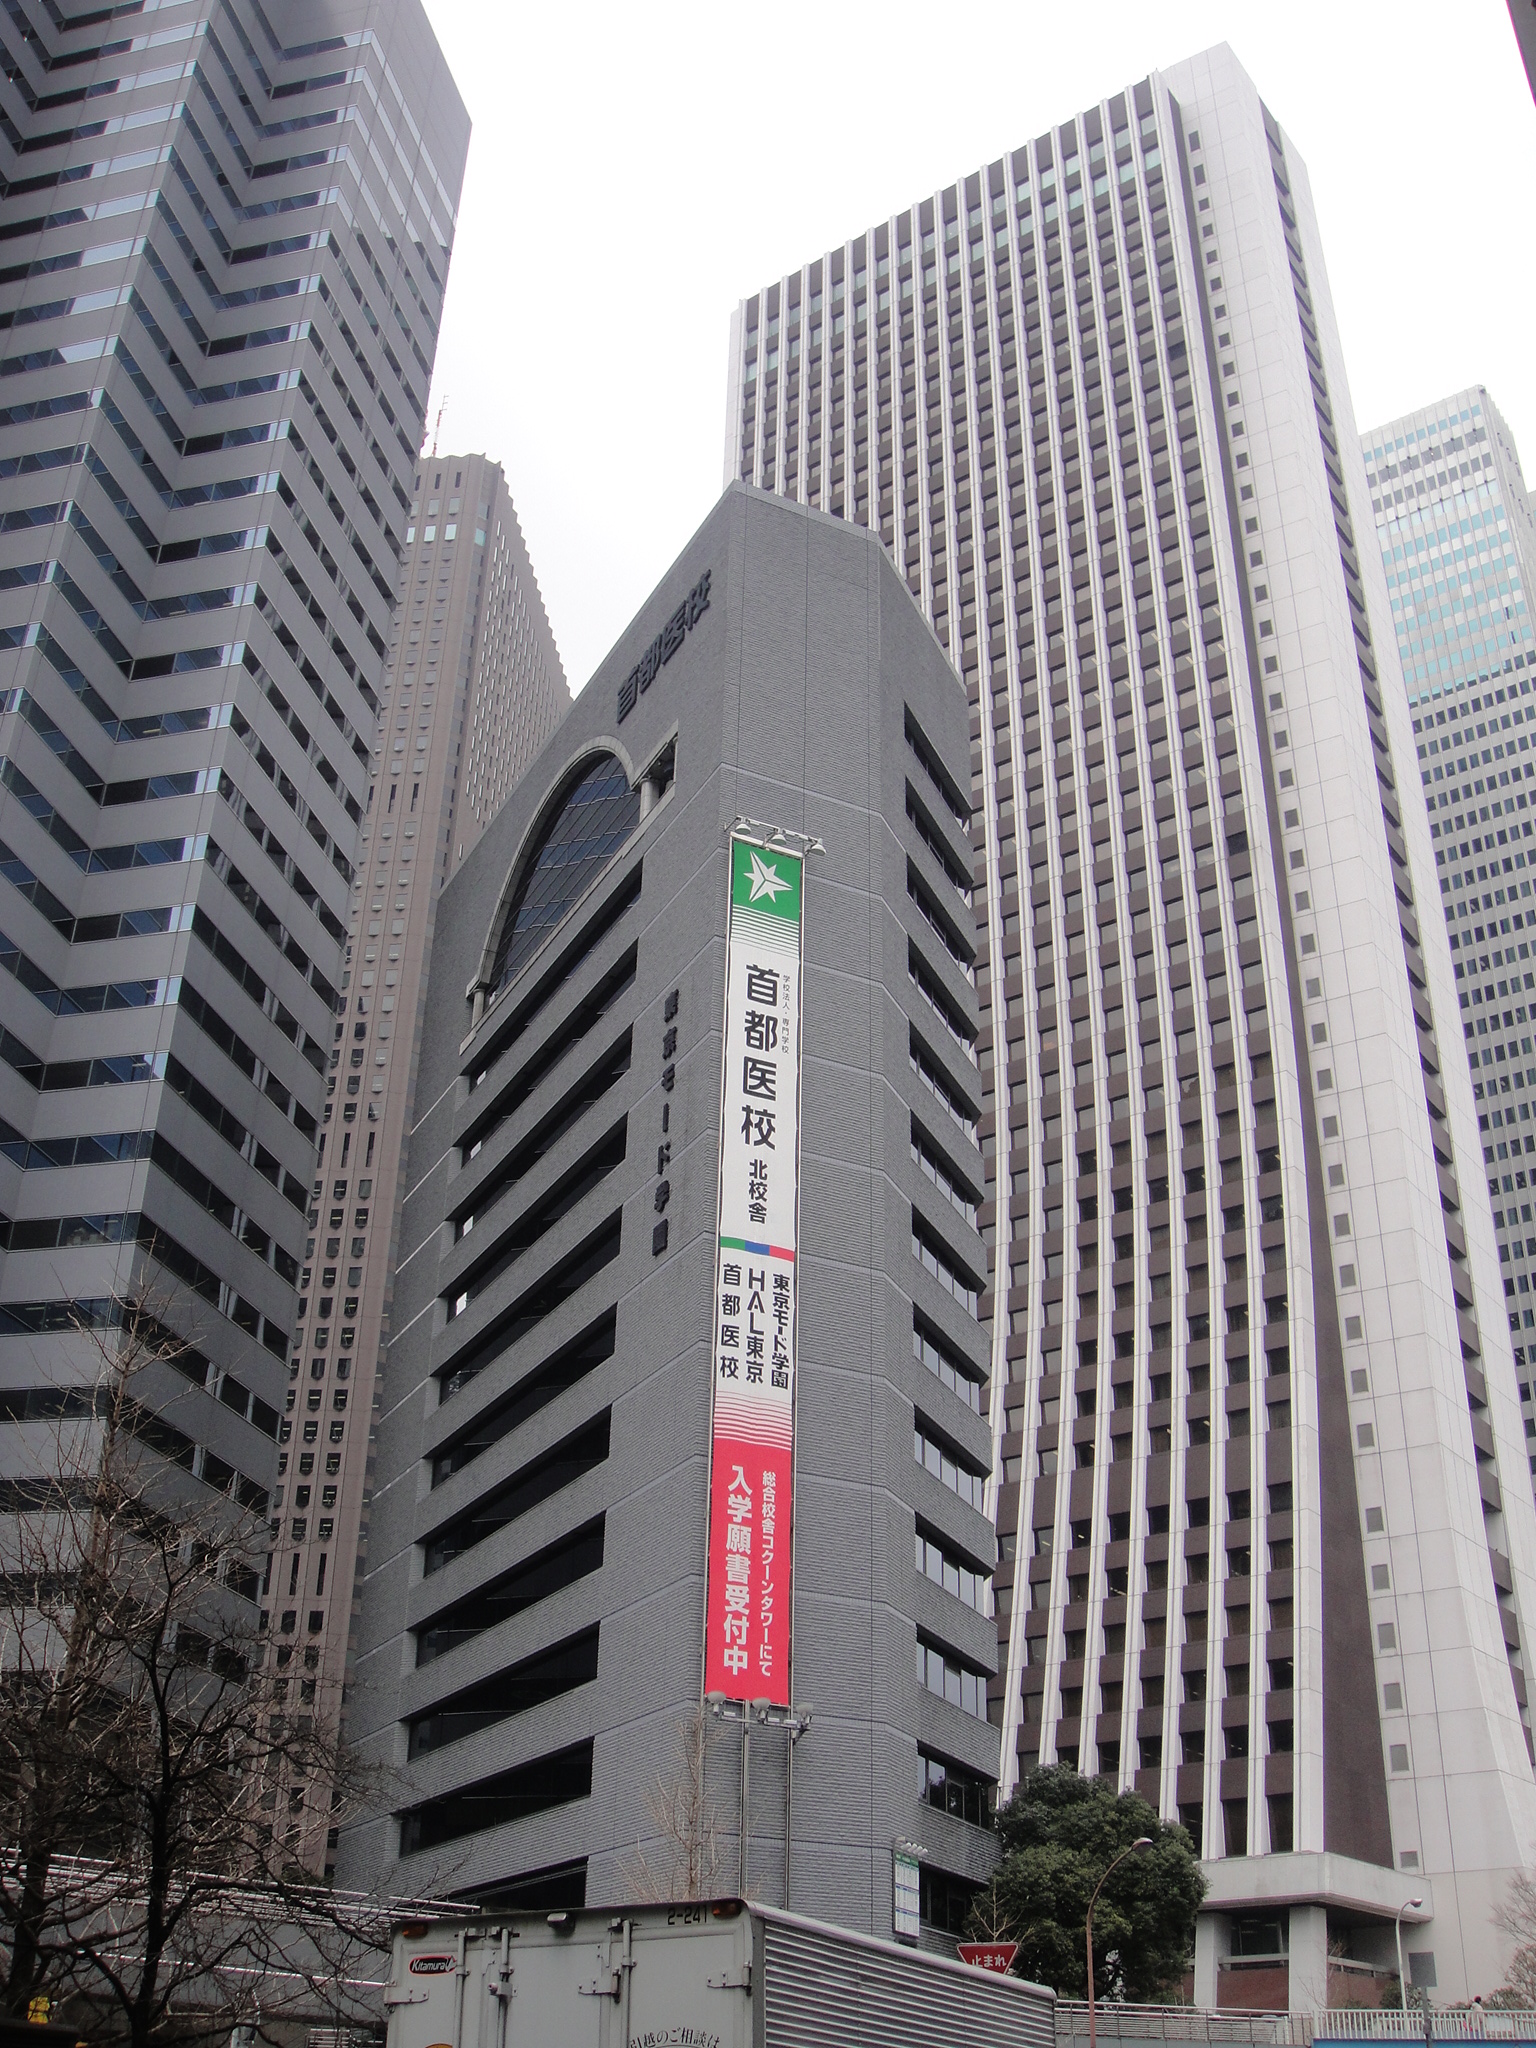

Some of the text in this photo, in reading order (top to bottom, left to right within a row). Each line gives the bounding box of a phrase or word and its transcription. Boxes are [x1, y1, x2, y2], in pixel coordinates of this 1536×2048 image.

[616, 568, 712, 726] 首都医校
[741, 963, 781, 1225] 首都医校 北校舎
[719, 1262, 742, 1380] 首都医校
[745, 1267, 766, 1385] HAL東京
[771, 1273, 791, 1390] 東京モード学園
[723, 1464, 753, 1677] 入学願書受付中
[759, 1470, 777, 1677] 総合校舎コクーンタワーにて
[411, 1958, 447, 1972] Kitamura
[667, 1903, 708, 1926] 2-241
[971, 1953, 1008, 1968] 止まれ
